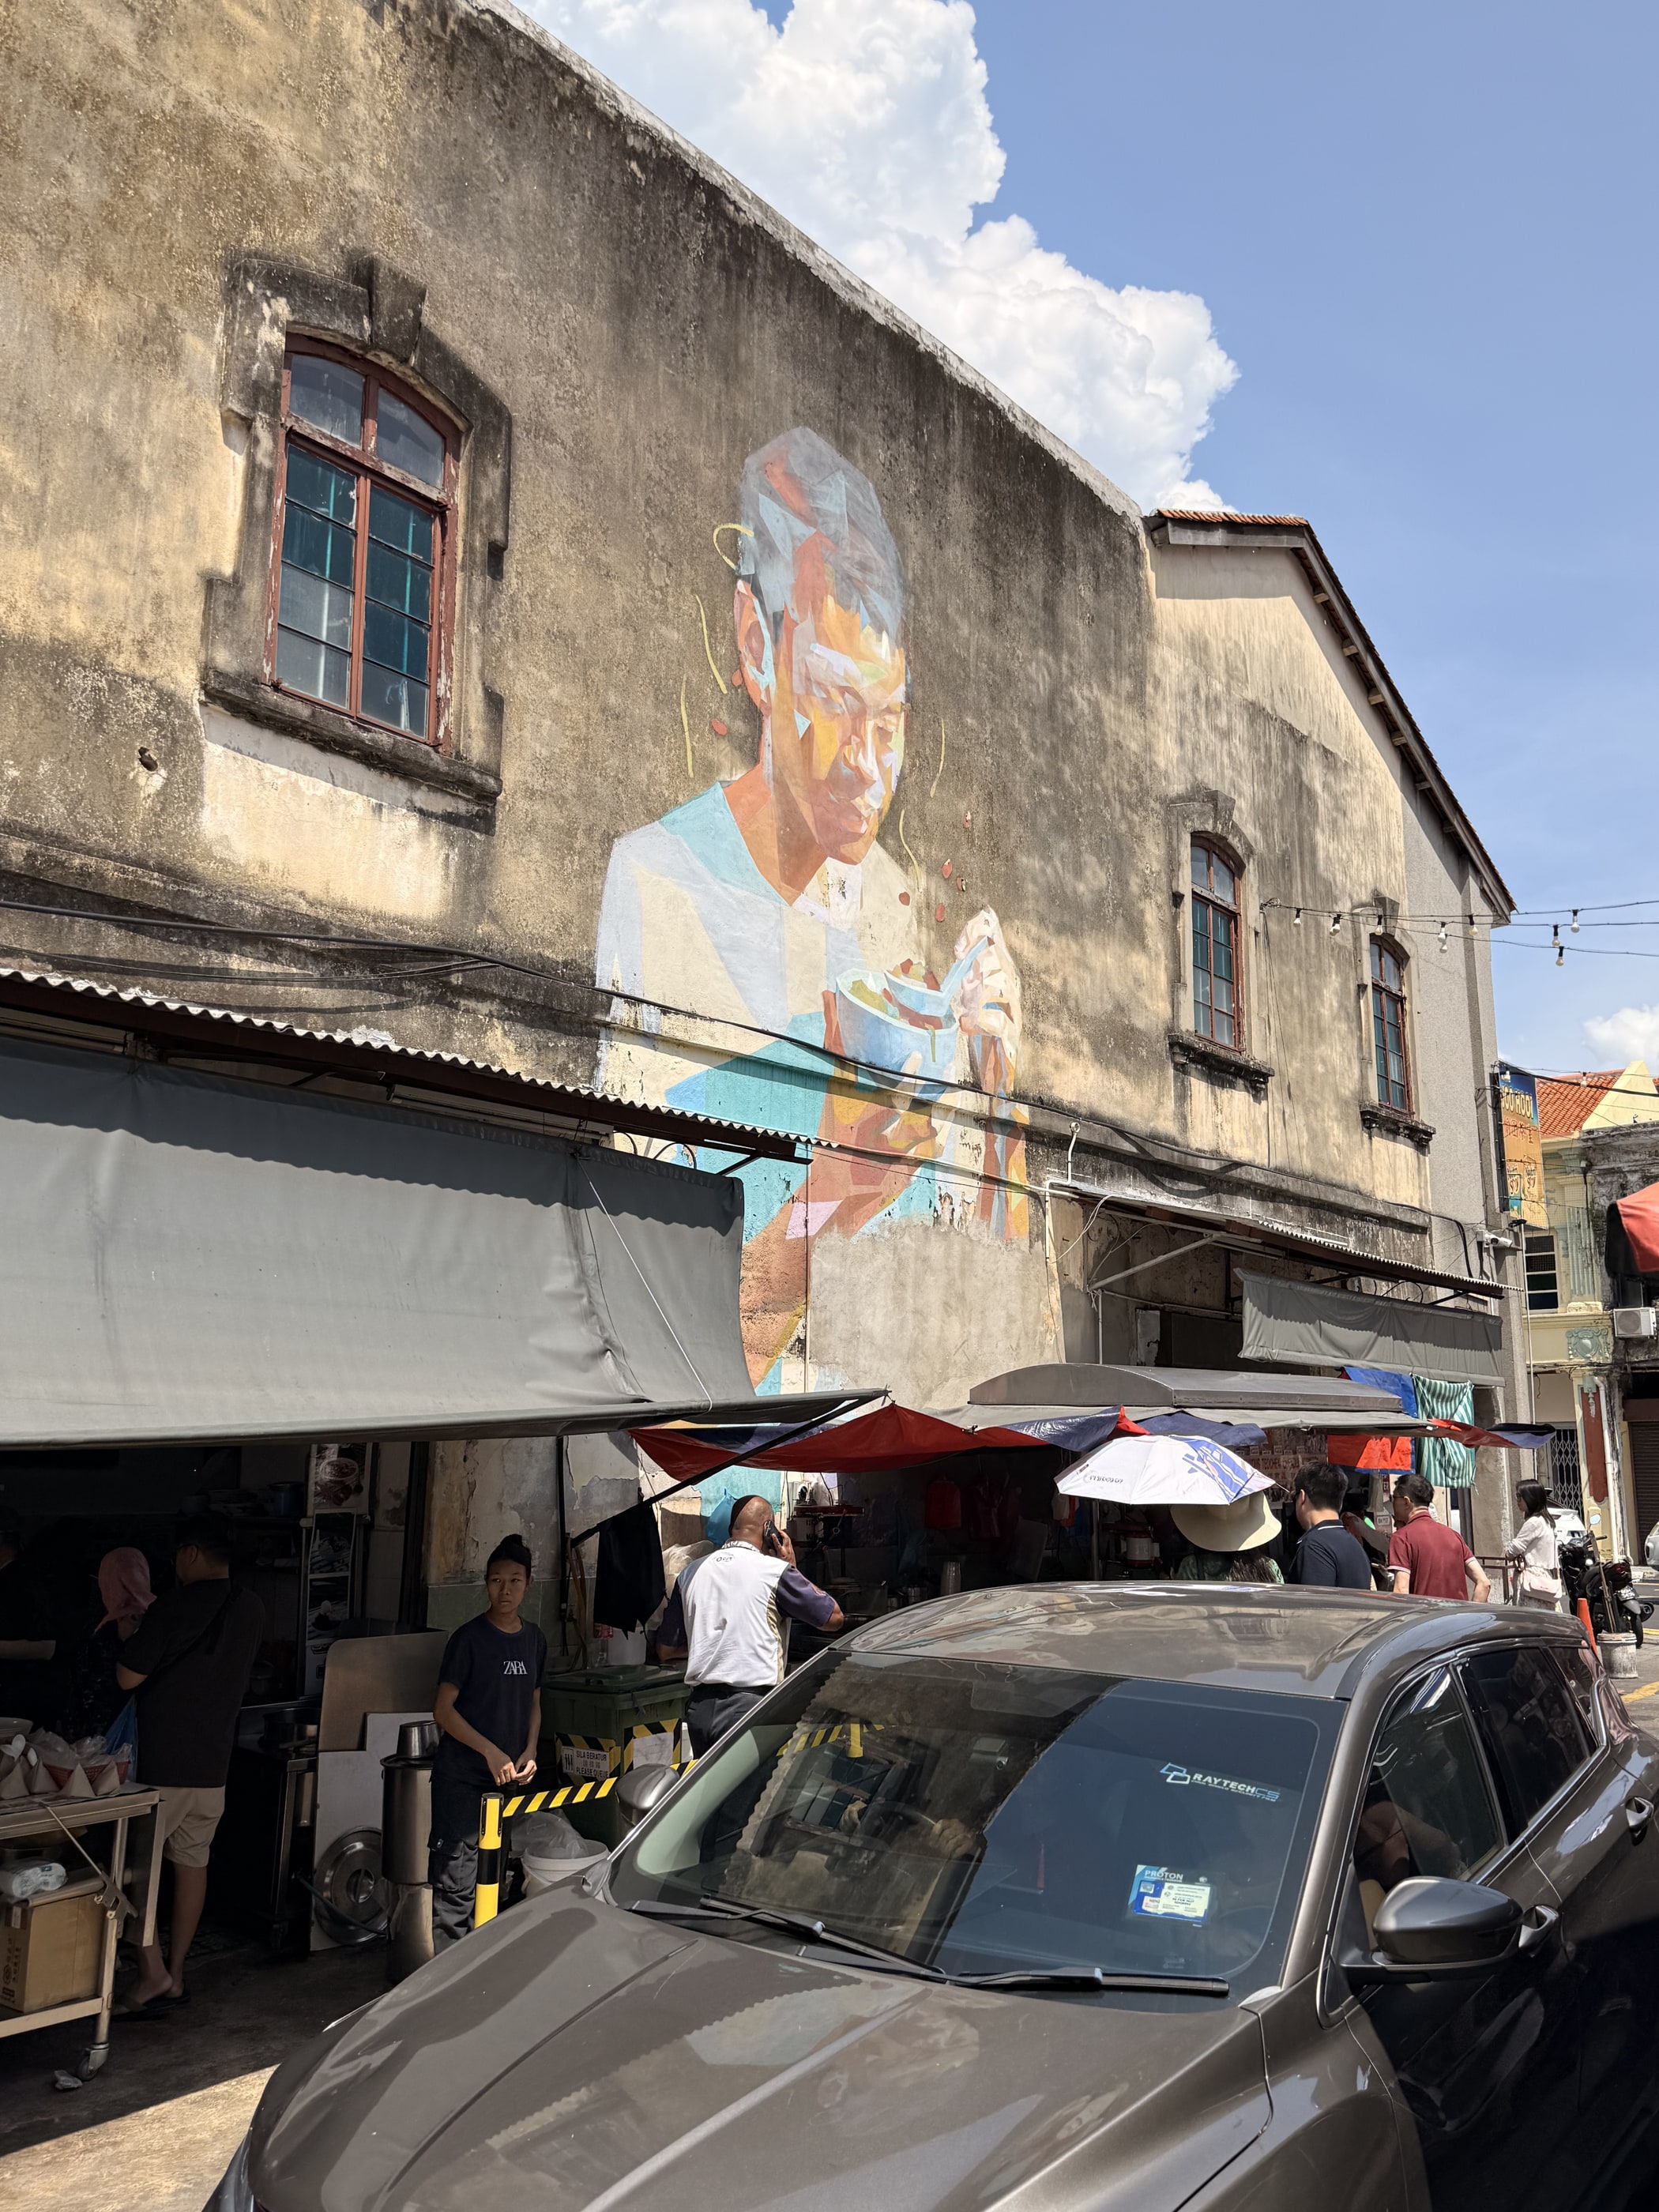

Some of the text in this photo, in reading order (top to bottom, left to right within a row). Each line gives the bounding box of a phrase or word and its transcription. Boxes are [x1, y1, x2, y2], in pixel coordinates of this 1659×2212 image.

[503, 1661, 528, 1675] ZARA
[586, 1751, 607, 1762] BERATUR
[576, 1767, 608, 1778] PLEASE QUEUE
